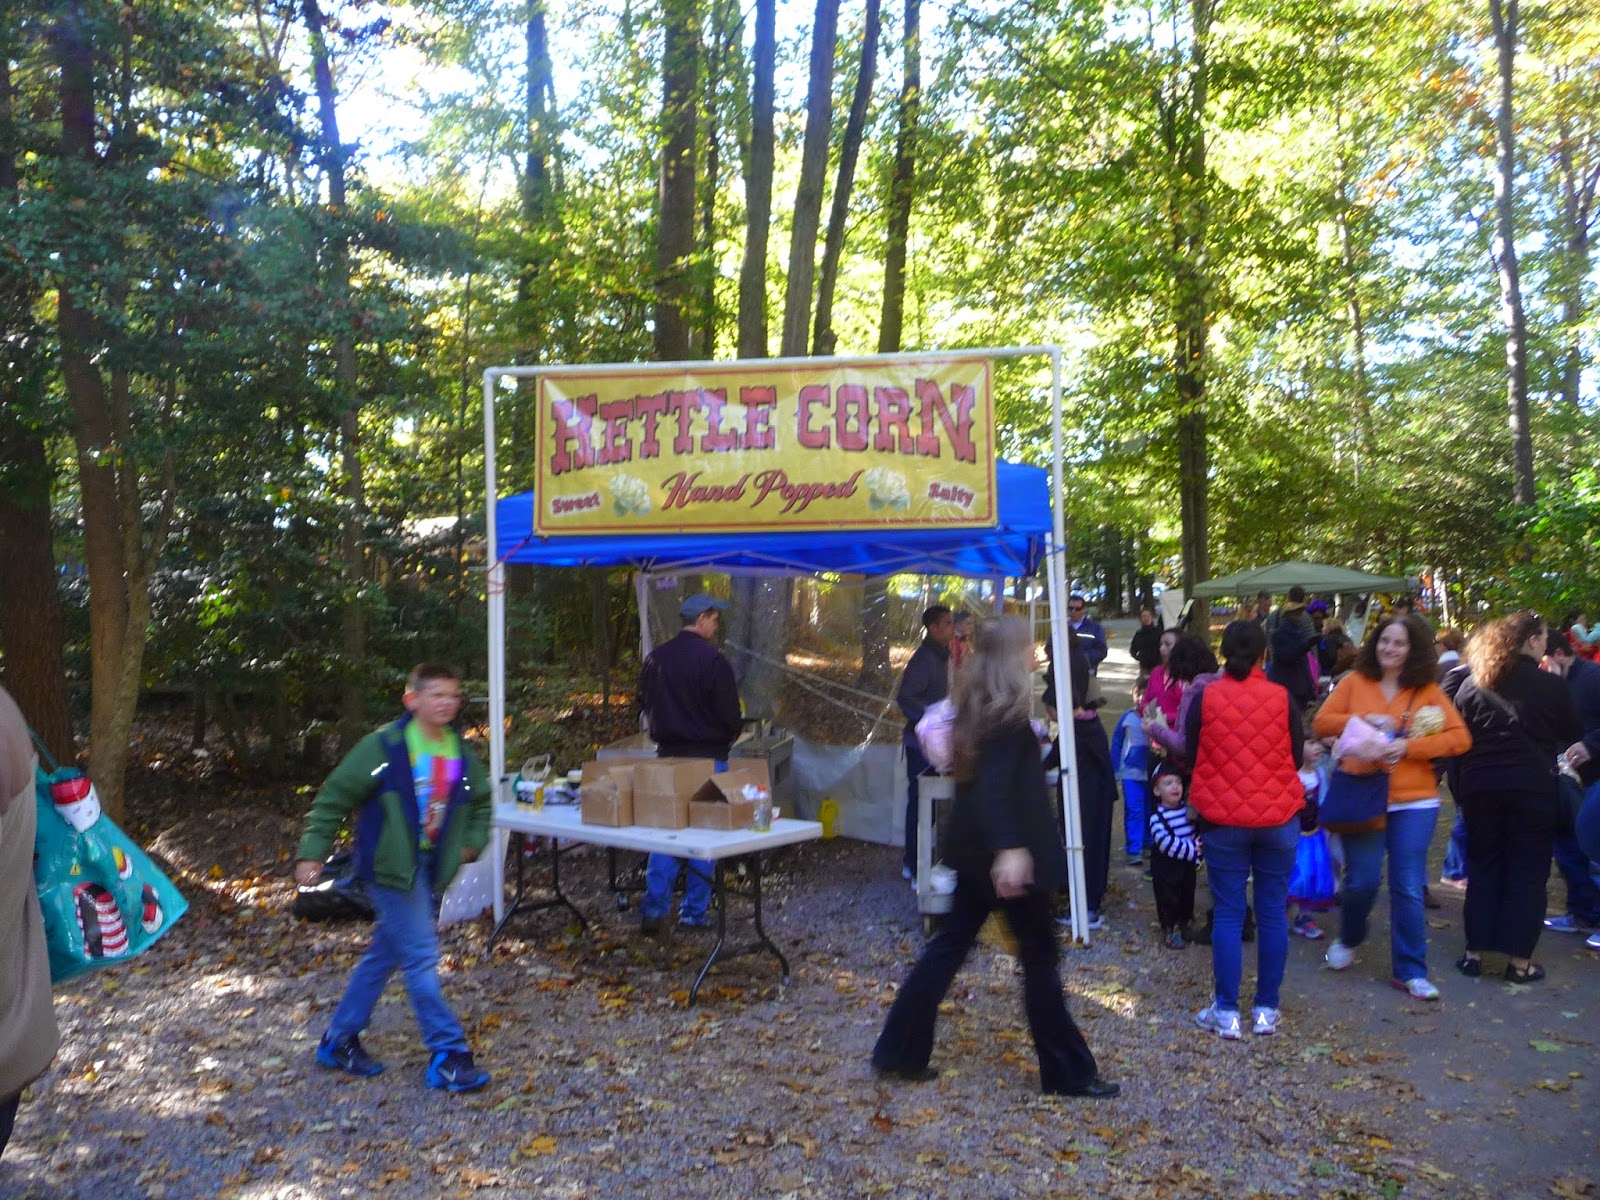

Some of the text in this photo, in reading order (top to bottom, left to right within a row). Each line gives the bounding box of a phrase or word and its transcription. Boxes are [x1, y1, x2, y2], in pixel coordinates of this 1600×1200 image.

[551, 378, 976, 475] KETTLE CORN
[551, 493, 600, 514] Sweet
[660, 469, 864, 514] Hand Popped
[928, 482, 975, 508] Salty
